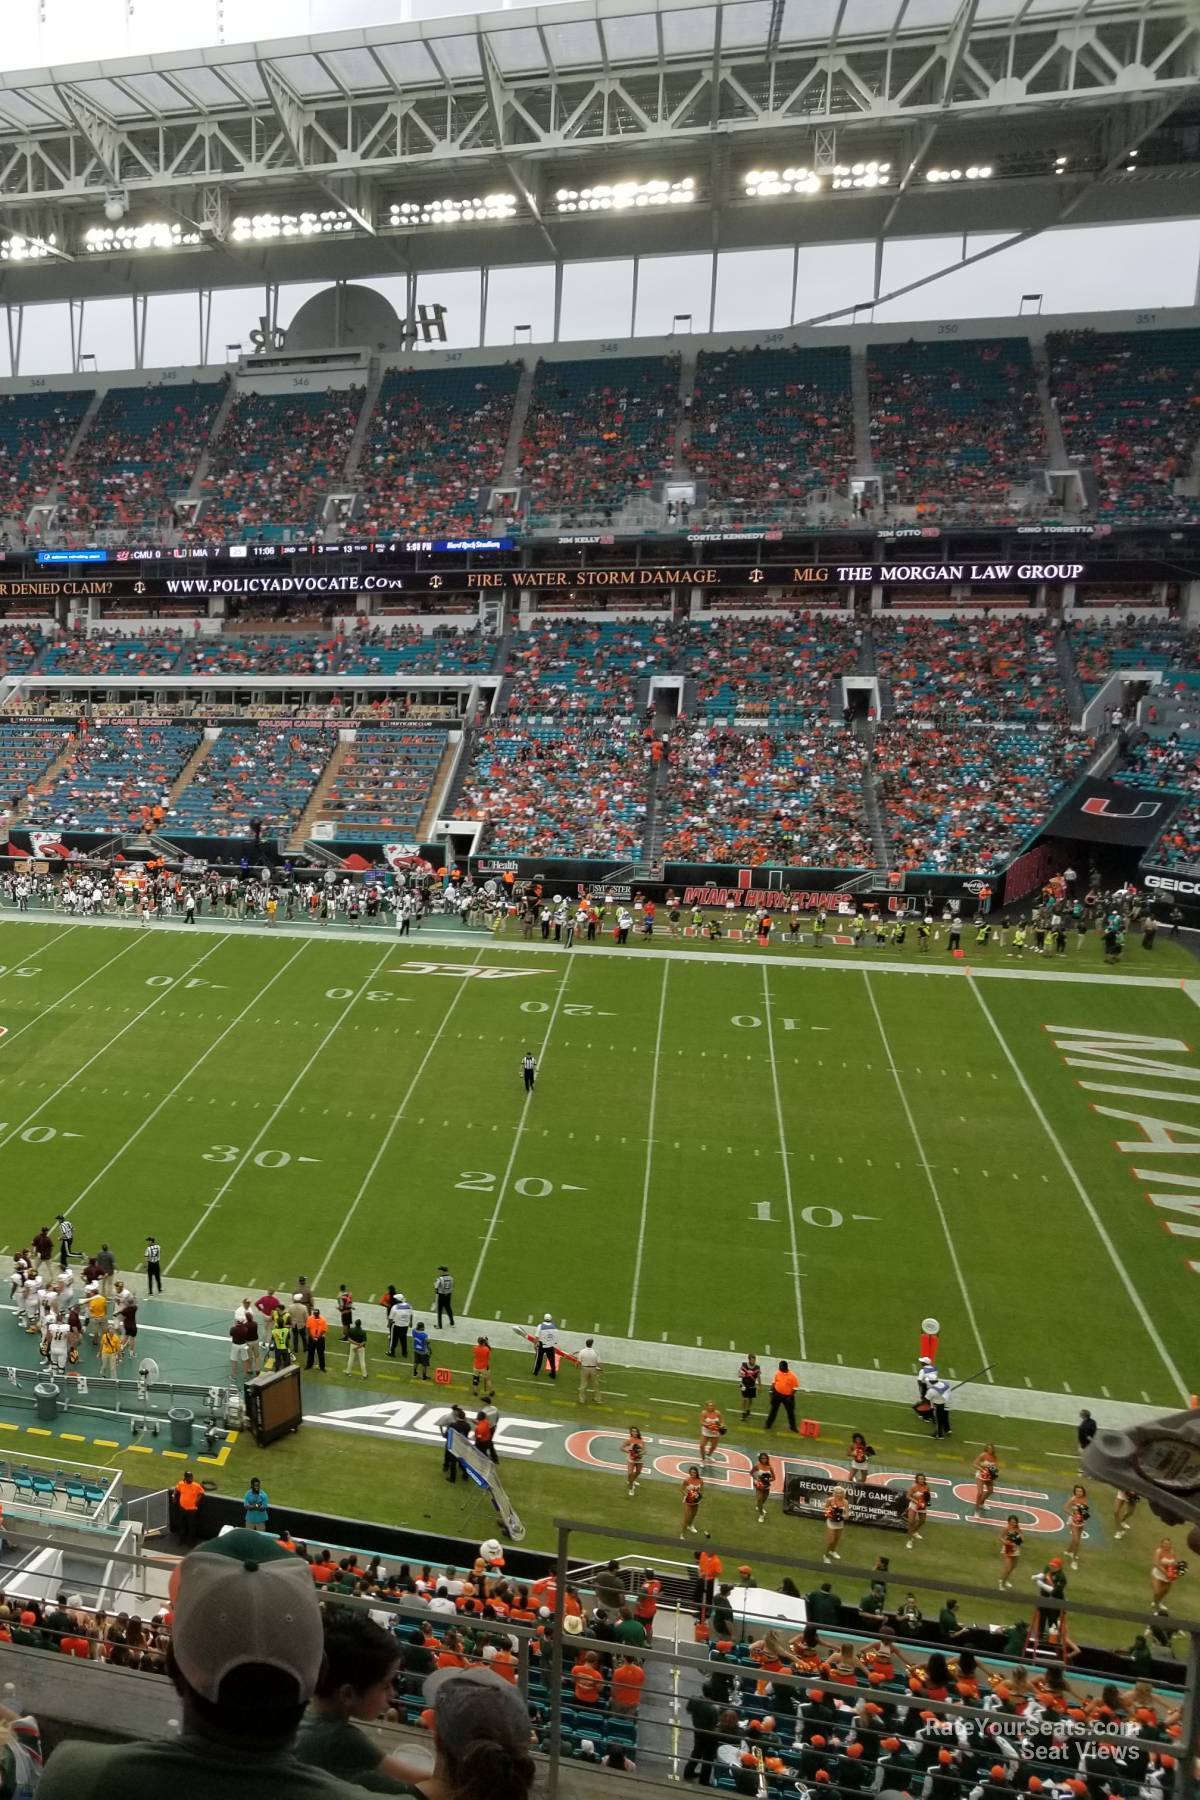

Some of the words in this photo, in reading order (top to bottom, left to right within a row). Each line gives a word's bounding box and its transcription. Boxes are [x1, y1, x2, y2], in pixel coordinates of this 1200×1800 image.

[938, 324, 958, 334] 350
[763, 333, 784, 344] 349
[292, 378, 310, 386] 346
[343, 545, 352, 553] 13
[468, 574, 507, 587] FIRE.
[513, 573, 571, 586] WATER.
[577, 571, 636, 585] STORM
[640, 570, 721, 584] DAMAGE.
[794, 568, 829, 582] MLG
[837, 567, 872, 581] THE
[880, 565, 963, 580] MORGAN
[971, 565, 1013, 579] LAW
[1017, 564, 1083, 579] GROUP
[11, 583, 60, 595] DENIED
[63, 582, 113, 594] CLAIM?
[325, 720, 361, 729] SOCIETY
[1081, 798, 1162, 818] U
[684, 888, 744, 906] MIAMI
[201, 1144, 292, 1168] 30
[453, 1171, 553, 1197] 20
[748, 1201, 843, 1228] 10
[868, 1507, 898, 1517] MEDICINE
